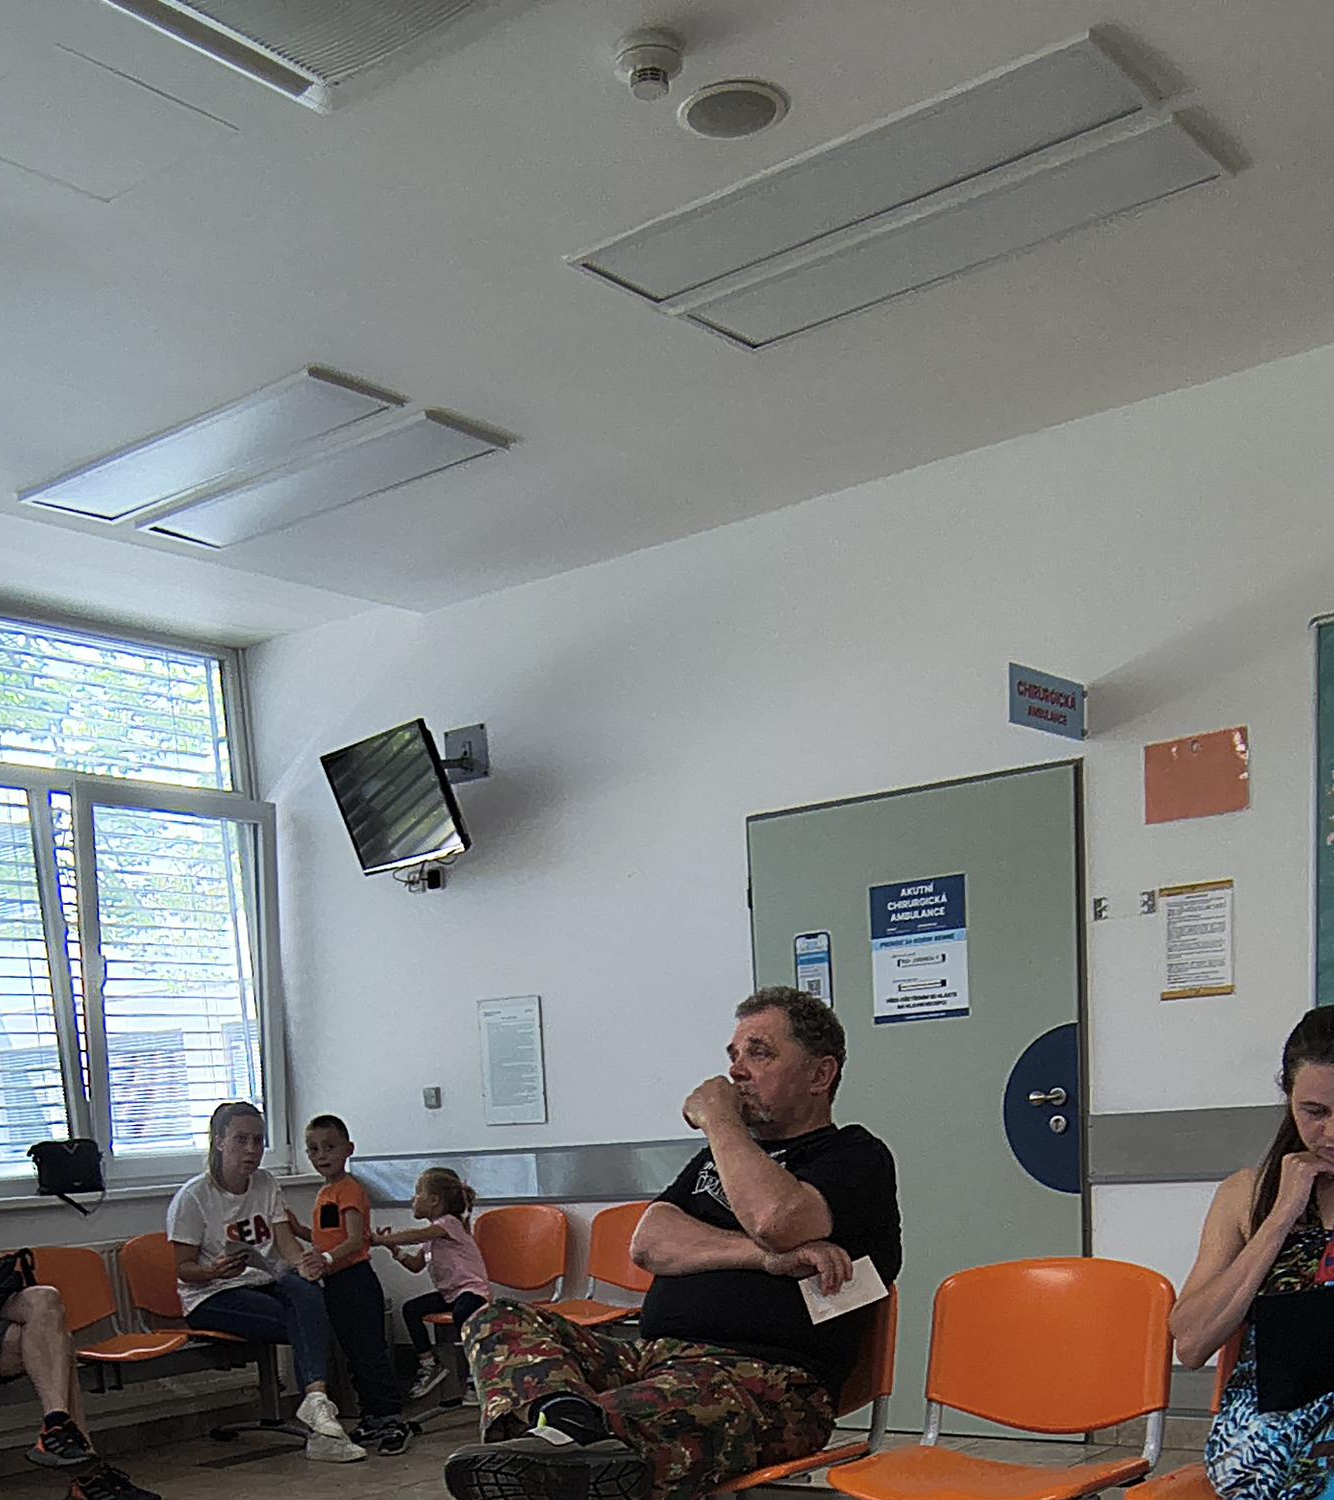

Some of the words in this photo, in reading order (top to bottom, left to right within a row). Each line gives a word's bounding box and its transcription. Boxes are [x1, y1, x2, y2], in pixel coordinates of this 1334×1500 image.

[900, 882, 934, 897] AKUTNÍ
[887, 892, 948, 911] CHIRURGICKÁ
[890, 906, 946, 923] AMBULANCE
[227, 1214, 271, 1245] SEA
